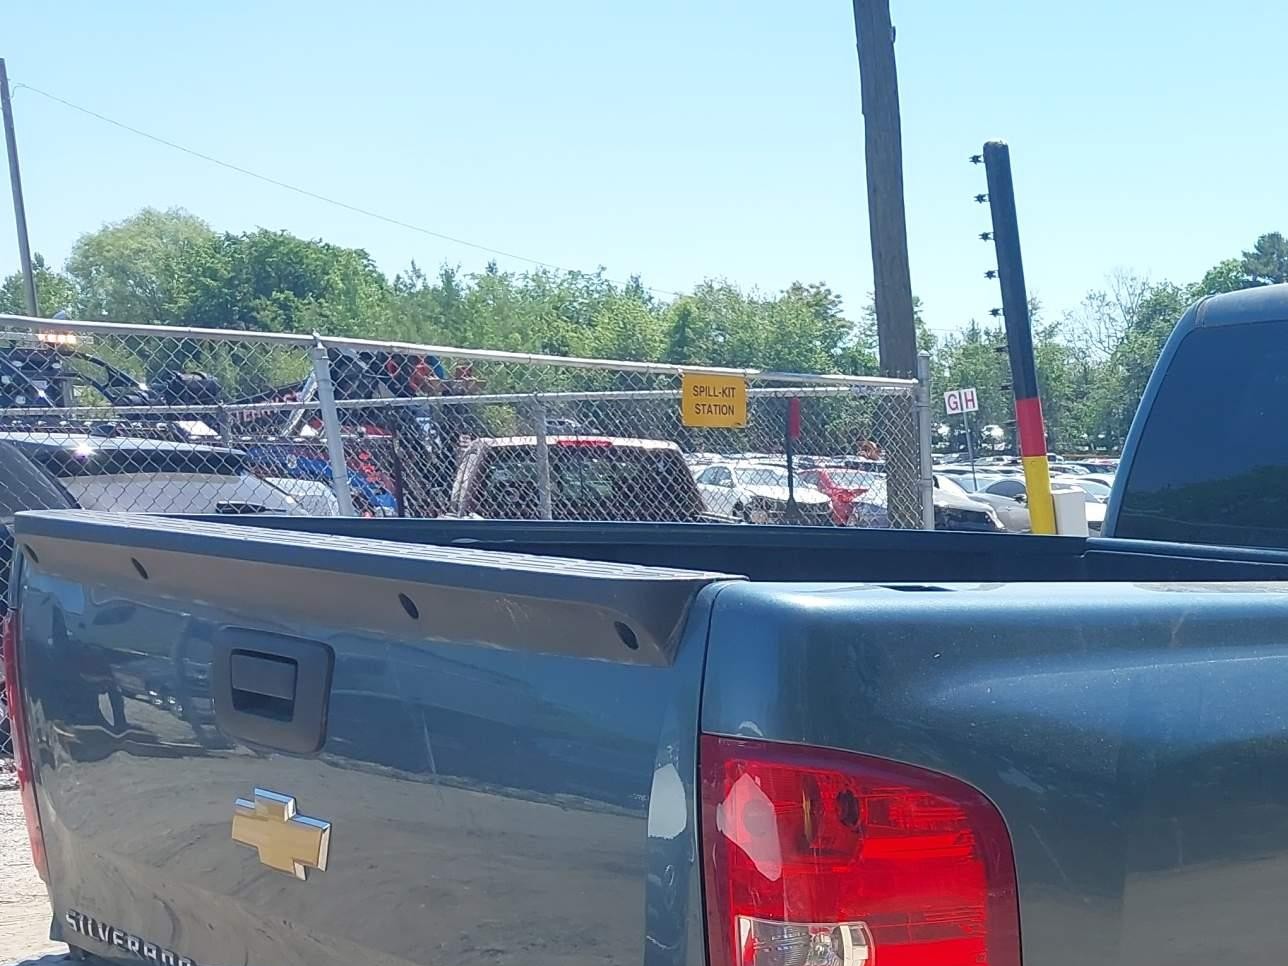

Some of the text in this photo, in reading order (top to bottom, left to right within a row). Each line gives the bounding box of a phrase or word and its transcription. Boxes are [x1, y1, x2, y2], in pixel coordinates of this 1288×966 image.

[692, 385, 736, 398] SPILL-KIT
[947, 390, 976, 411] G H
[694, 403, 735, 416] STATION
